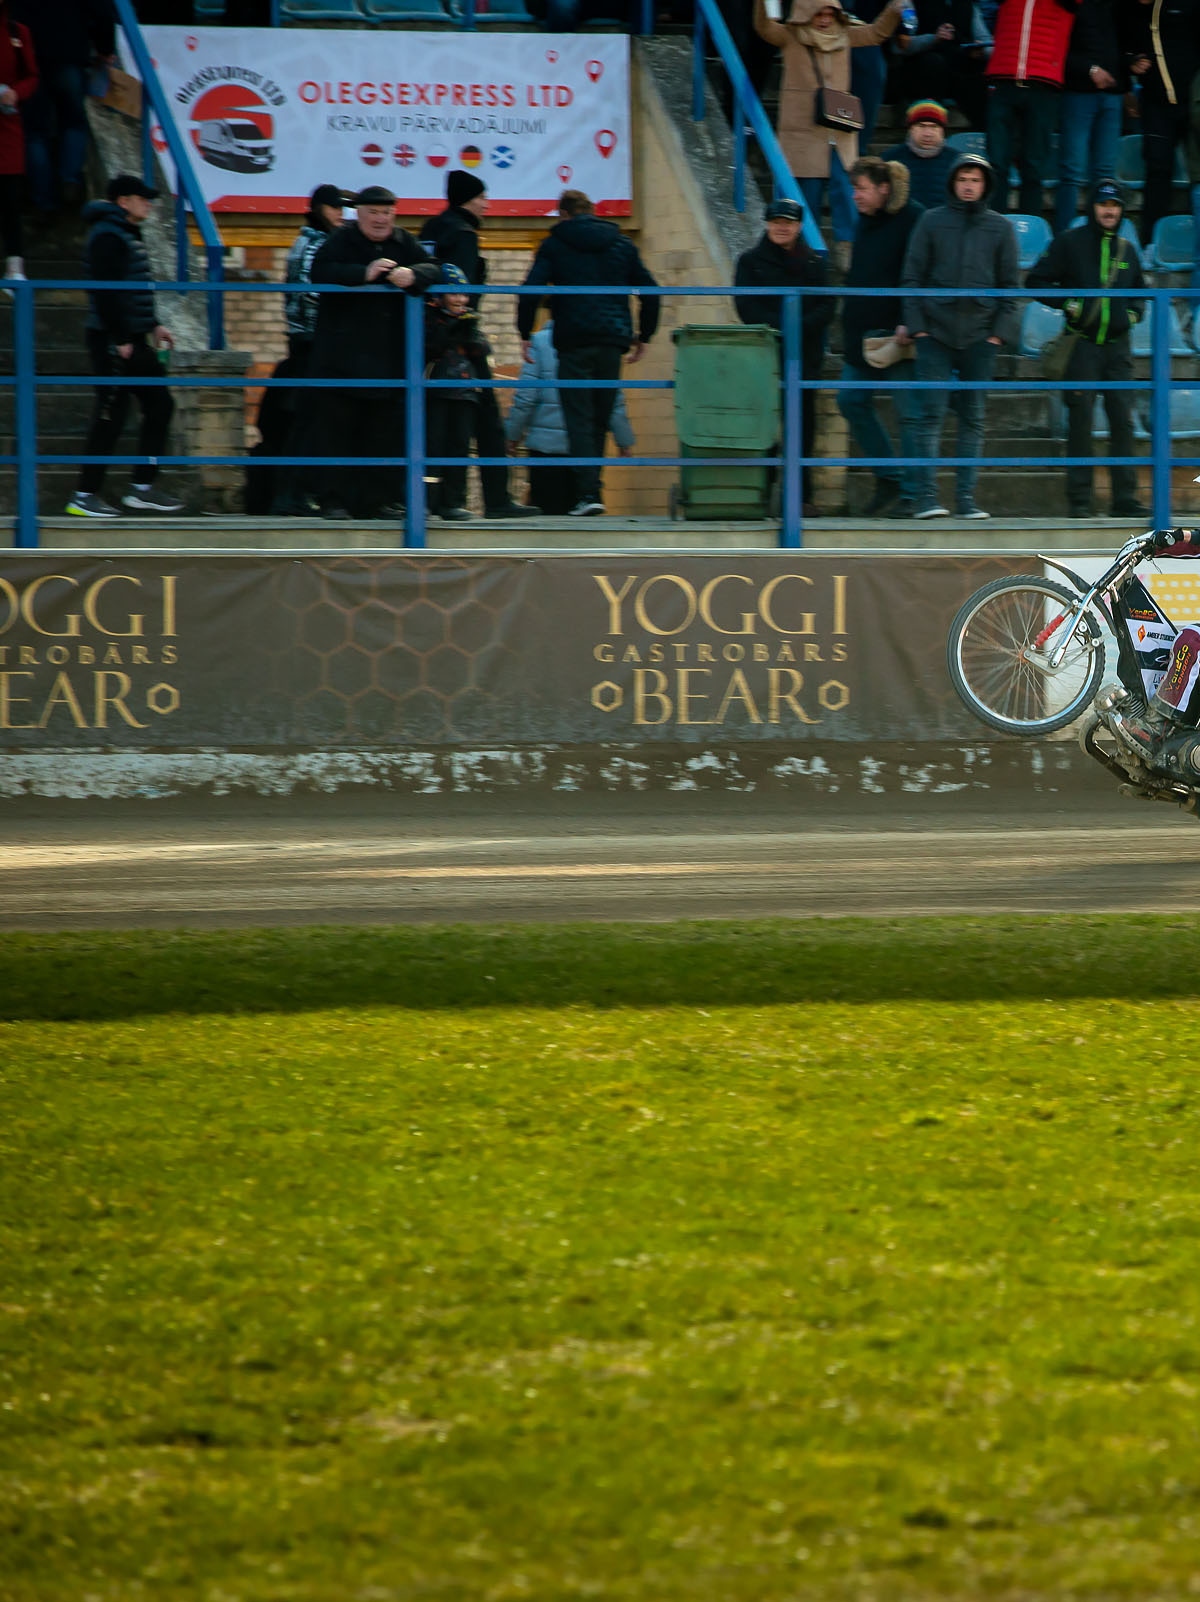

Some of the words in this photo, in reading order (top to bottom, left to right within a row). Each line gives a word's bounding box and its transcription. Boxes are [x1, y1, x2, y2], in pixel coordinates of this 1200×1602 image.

[298, 80, 516, 108] OLEGSEXPRESS
[525, 84, 574, 108] LTD
[326, 114, 397, 132] KRAVU
[400, 113, 548, 135] PĀRVADĀJUMI
[592, 574, 849, 635] YOGGI
[593, 640, 849, 663] GASTROBĀRS
[1175, 652, 1192, 690] LONDON
[0, 670, 150, 729] EAR
[632, 668, 823, 725] BEAR
